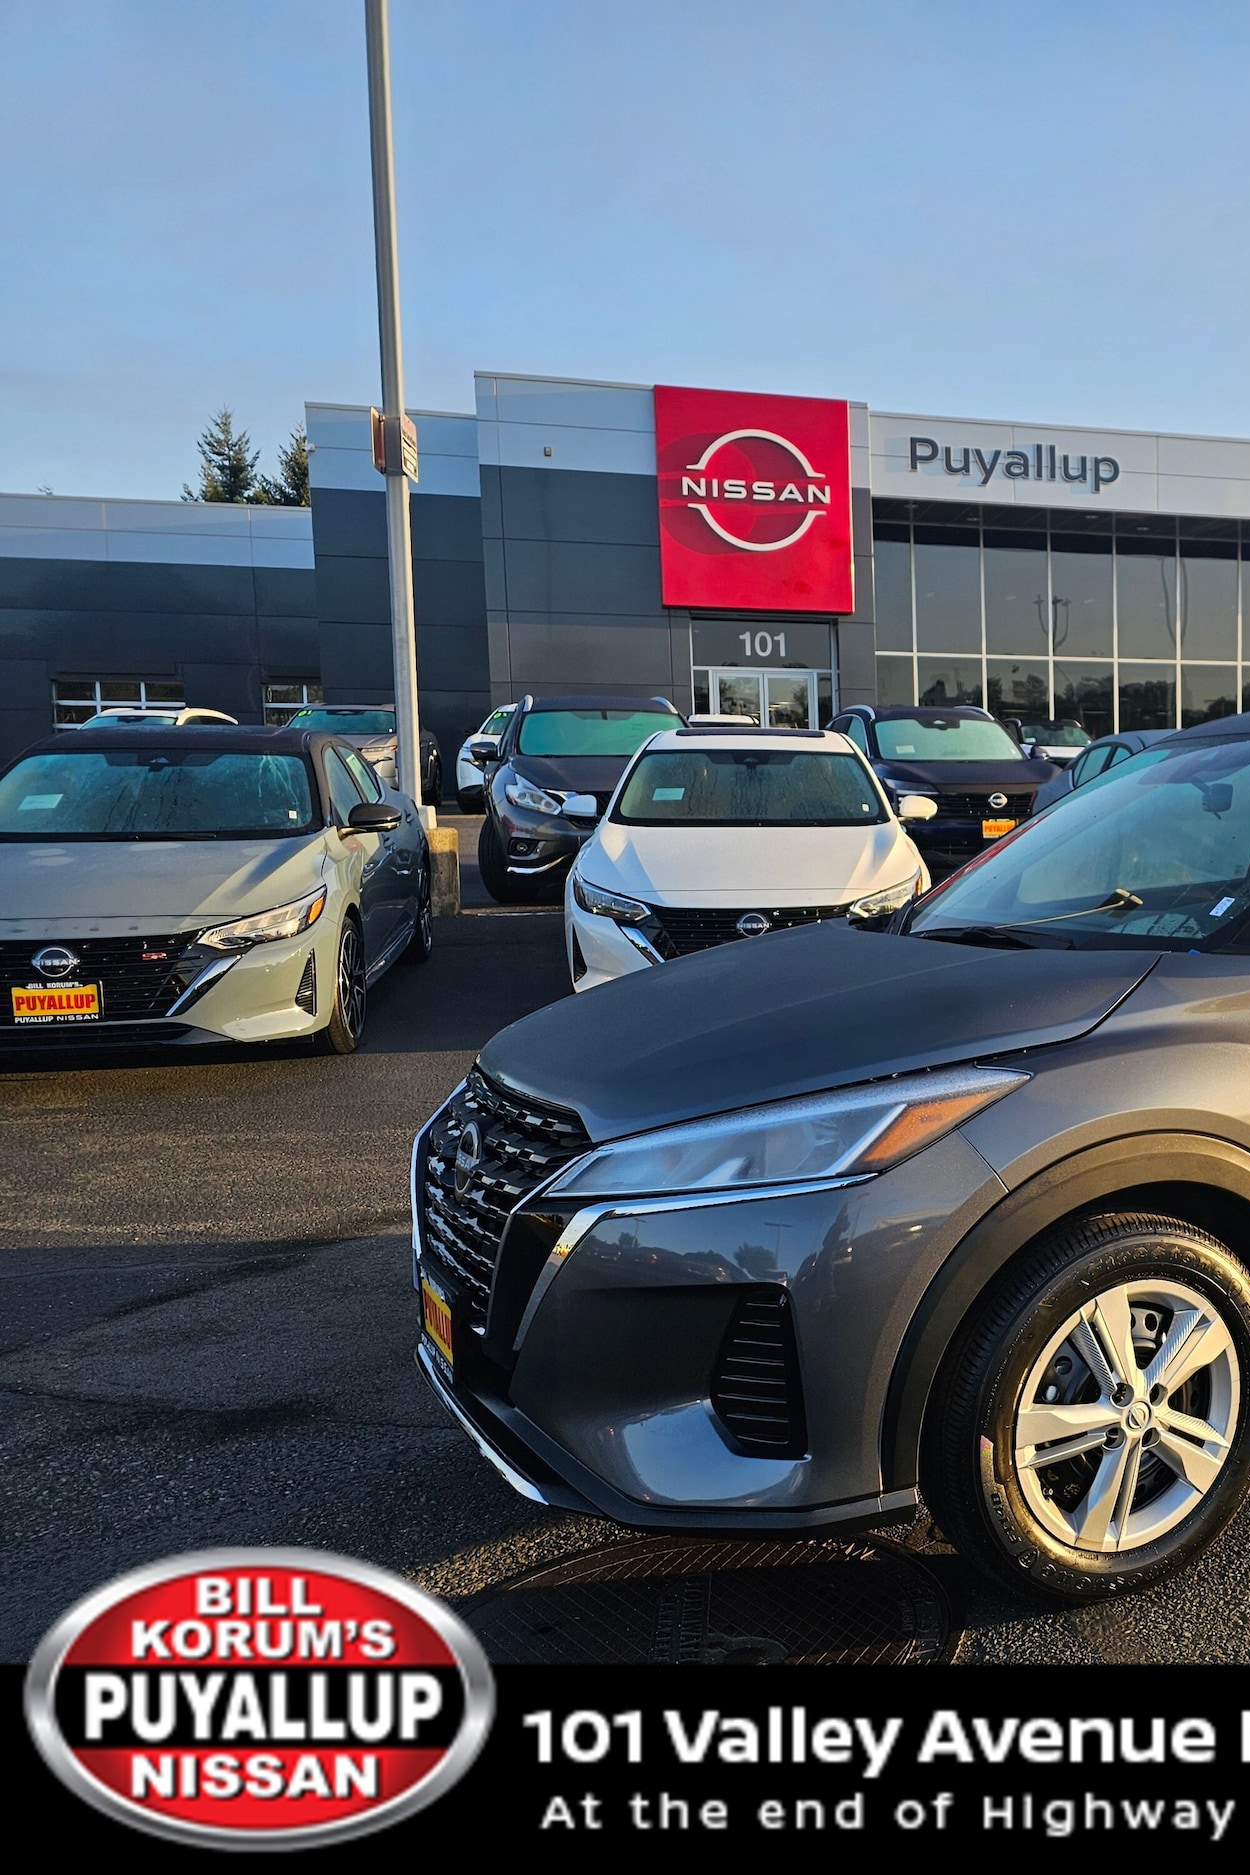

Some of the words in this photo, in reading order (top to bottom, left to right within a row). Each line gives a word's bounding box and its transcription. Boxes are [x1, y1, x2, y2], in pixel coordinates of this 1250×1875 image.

[909, 436, 1120, 493] Puyallup
[681, 476, 830, 504] NISSAN
[739, 631, 786, 657] 101
[30, 957, 79, 966] NISSAN
[15, 993, 96, 1011] PUYALLUP
[14, 1016, 54, 1024] PUYALLUP
[56, 1013, 99, 1021] NISSAN
